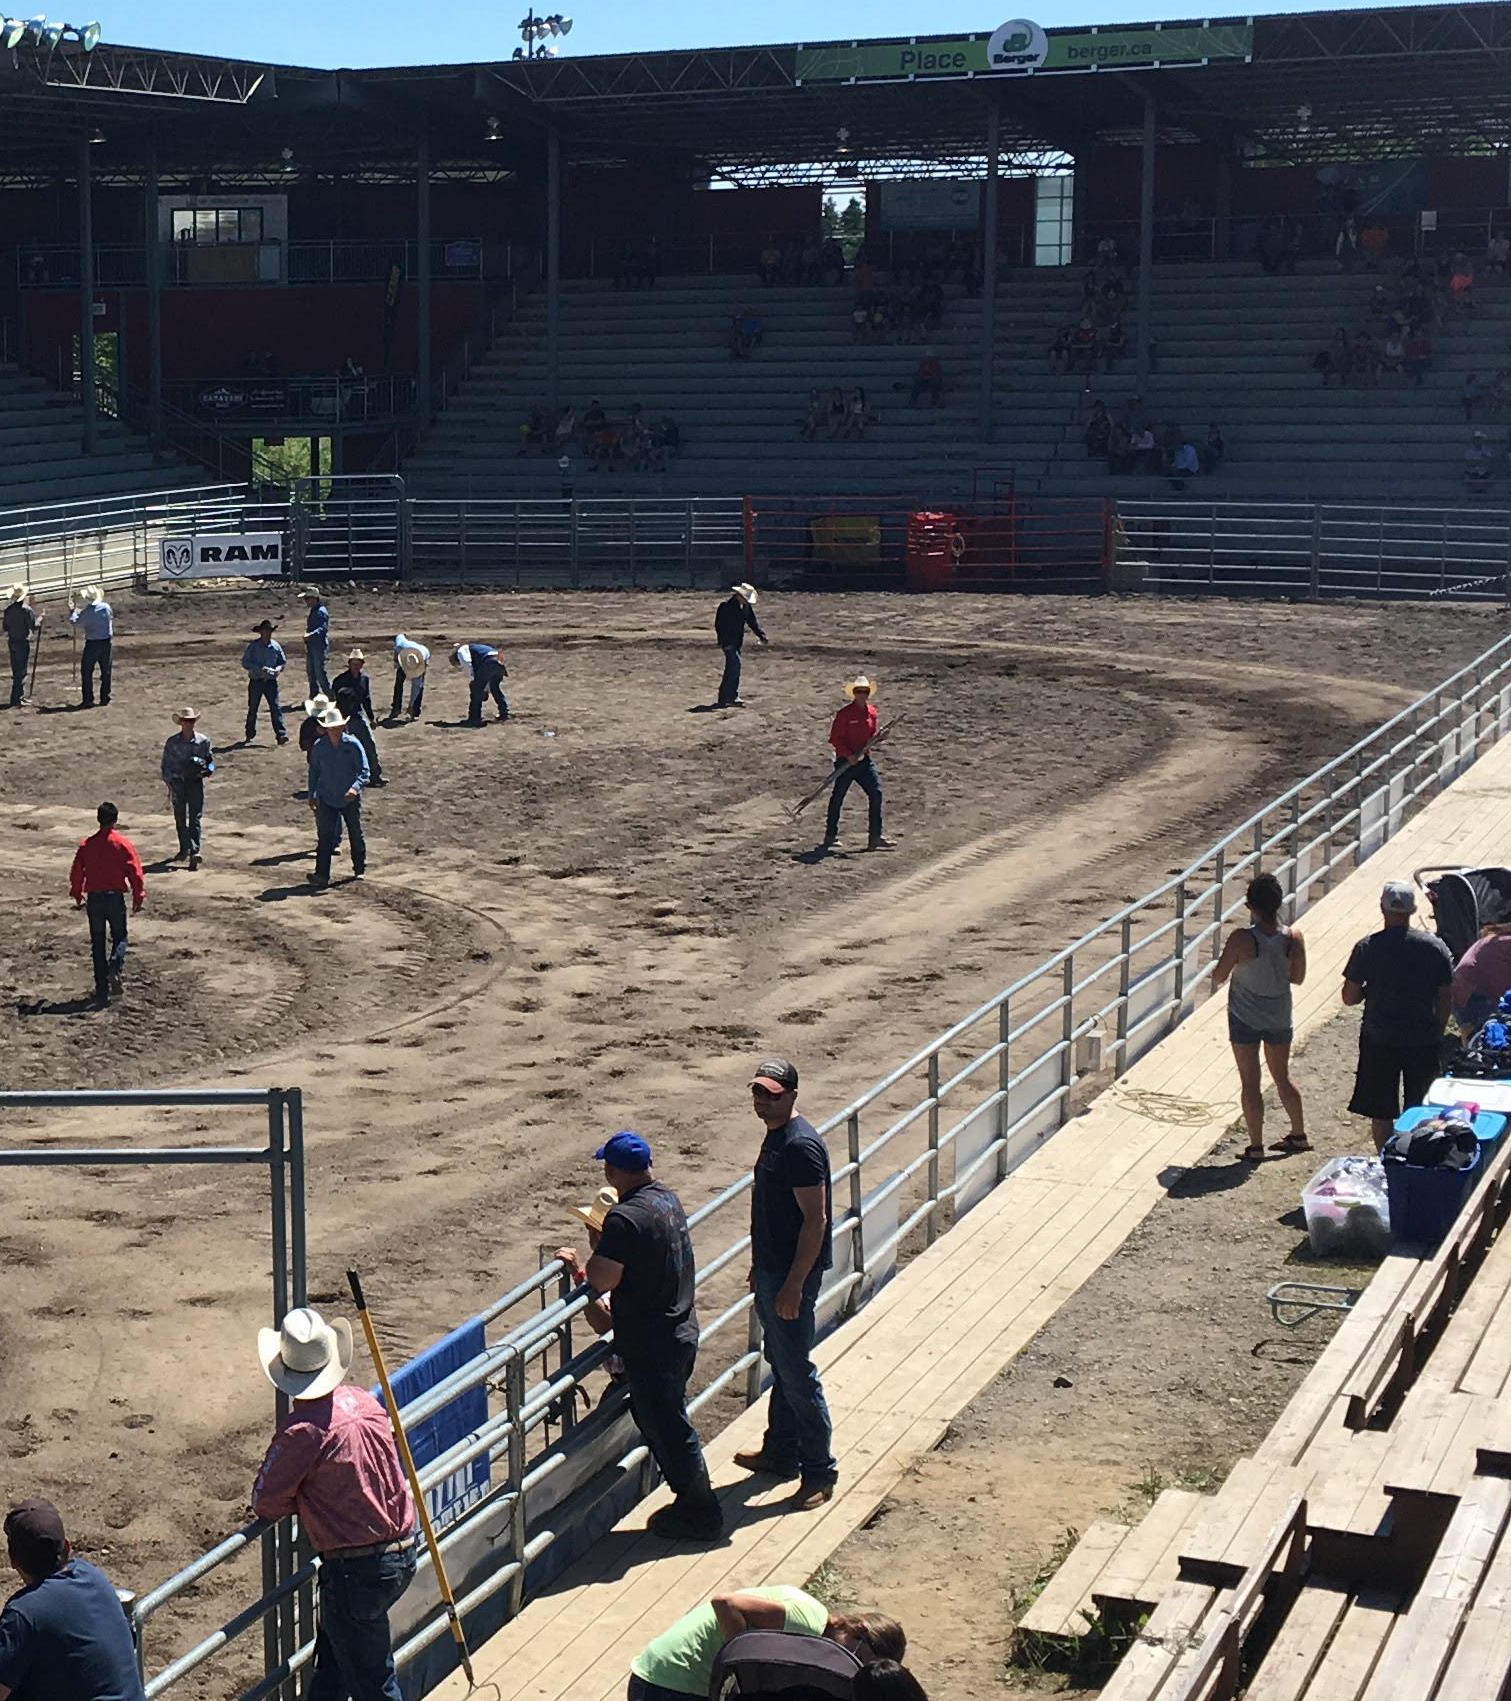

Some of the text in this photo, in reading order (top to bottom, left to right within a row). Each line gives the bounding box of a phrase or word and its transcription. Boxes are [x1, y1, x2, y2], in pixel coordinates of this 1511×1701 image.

[899, 50, 967, 71] Place
[993, 51, 1040, 66] Berger
[1067, 41, 1153, 61] berger.ca
[200, 544, 279, 562] RAM
